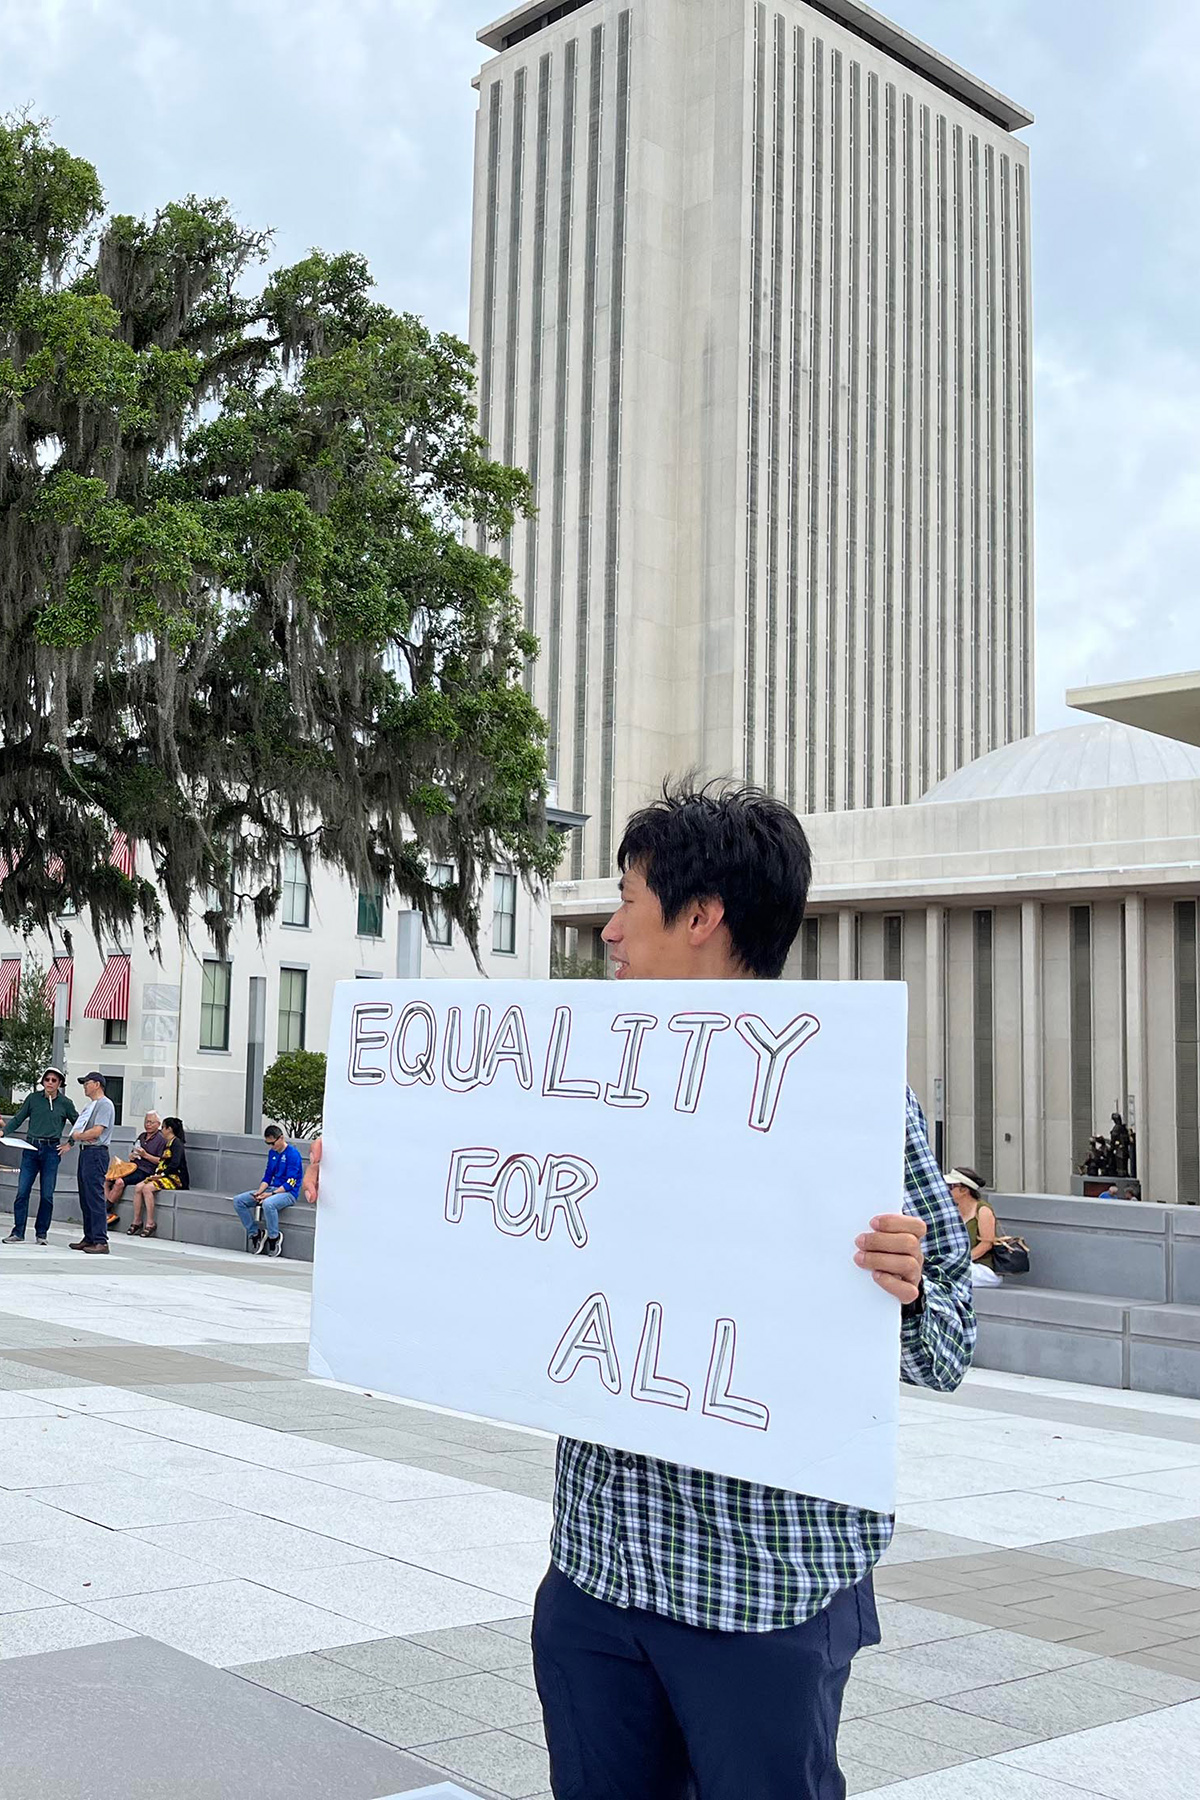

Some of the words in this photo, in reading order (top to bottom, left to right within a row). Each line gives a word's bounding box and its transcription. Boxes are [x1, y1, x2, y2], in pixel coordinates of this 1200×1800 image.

[347, 1001, 820, 1132] EQUALITY
[444, 1147, 598, 1248] FOR
[548, 1292, 770, 1430] ALL
